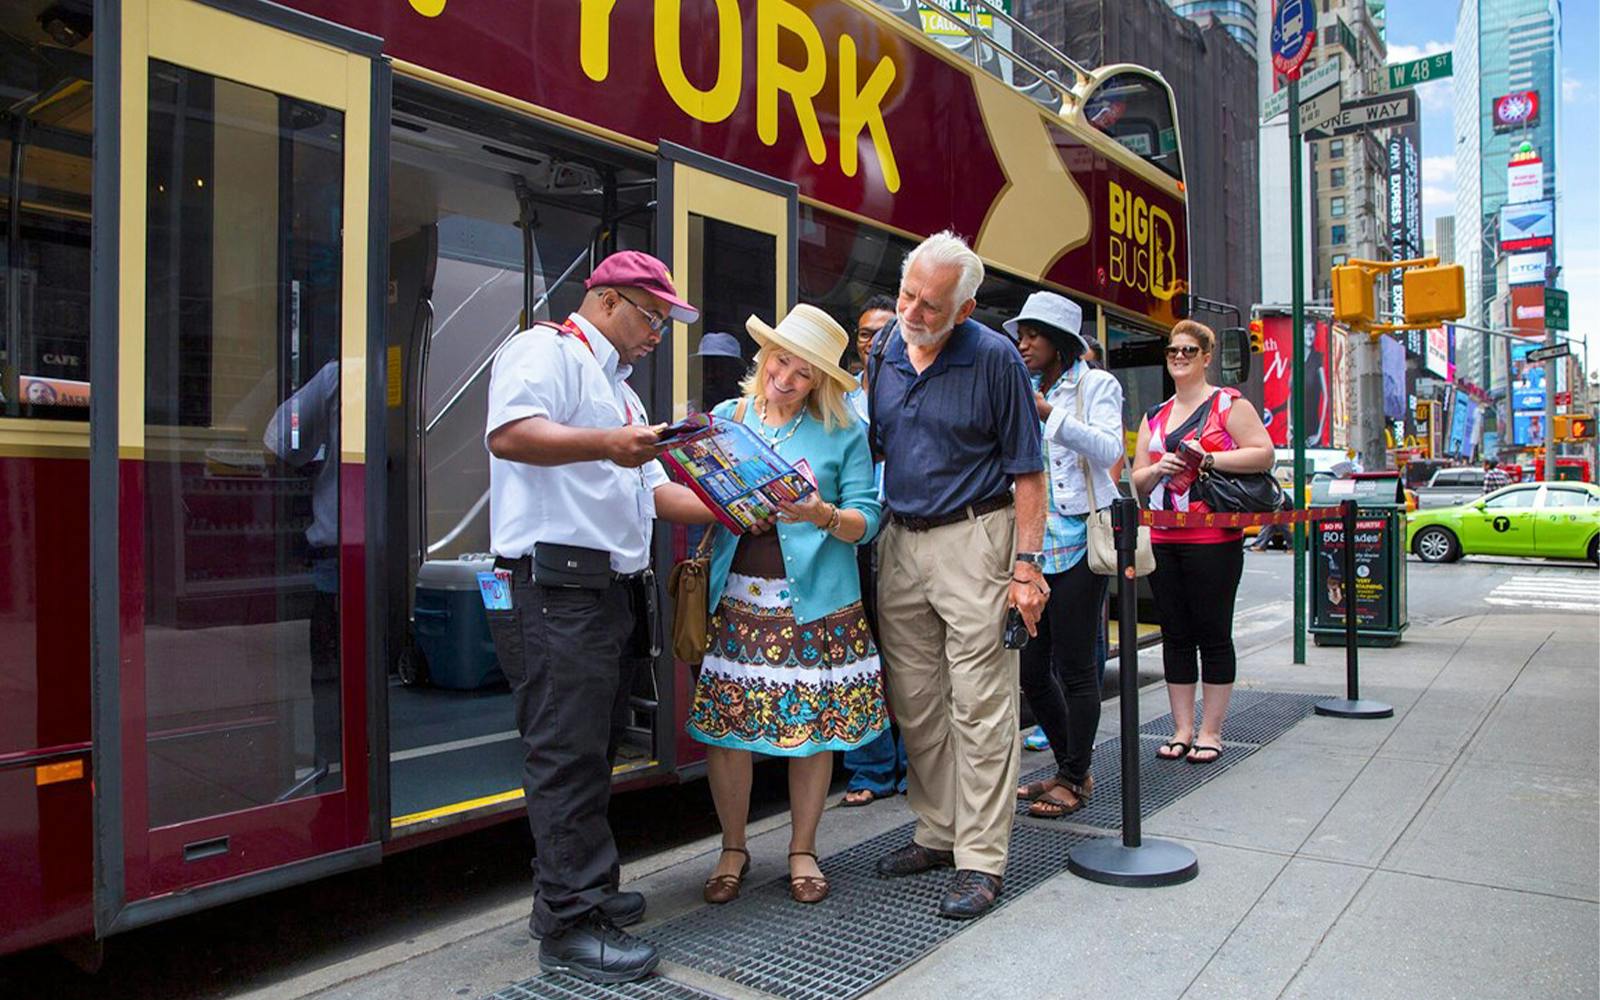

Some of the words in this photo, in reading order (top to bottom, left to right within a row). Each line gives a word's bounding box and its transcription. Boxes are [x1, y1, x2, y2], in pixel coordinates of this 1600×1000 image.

[1394, 66, 1405, 86] W
[1411, 60, 1430, 81] 48
[1435, 55, 1447, 68] ST
[1320, 112, 1351, 128] ONE
[1366, 102, 1401, 120] WAY
[1109, 180, 1149, 246] BIG
[1391, 174, 1402, 225] EXPRESS
[1109, 235, 1149, 293] BUS
[1520, 264, 1543, 272] TDK
[43, 353, 80, 367] CAFE
